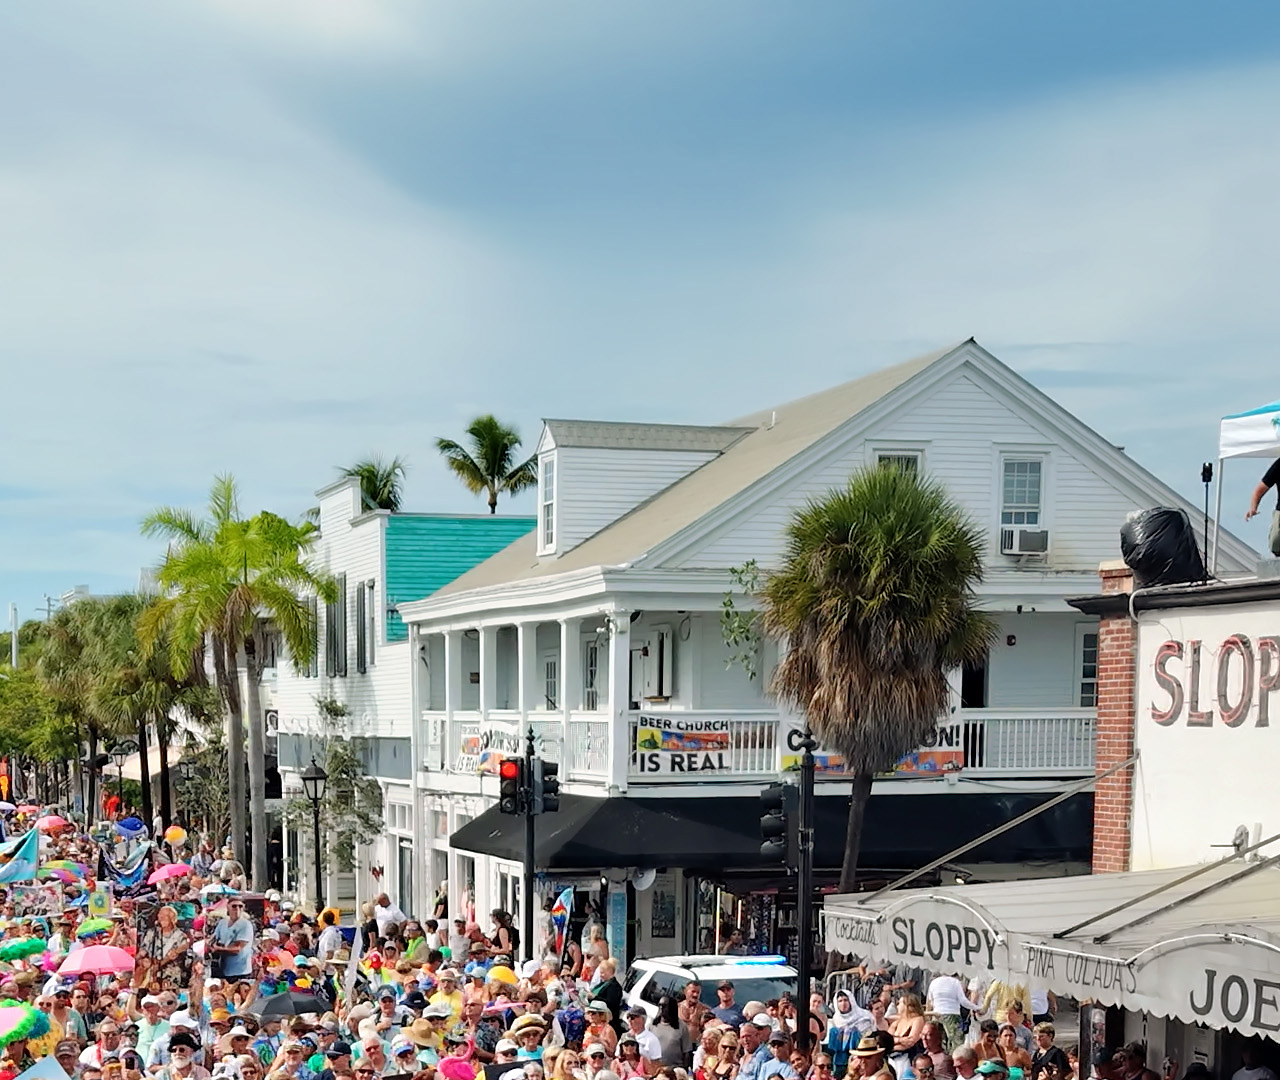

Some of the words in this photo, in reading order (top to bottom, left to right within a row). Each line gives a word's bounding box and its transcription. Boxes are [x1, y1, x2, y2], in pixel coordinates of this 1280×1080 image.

[640, 716, 672, 729] BEER
[677, 720, 729, 731] CHURCH
[640, 753, 661, 772] IS
[670, 752, 730, 772] REAL
[835, 917, 879, 946] Cocktails
[892, 917, 998, 971] SLOPPY
[1065, 956, 1139, 995] COLADAS
